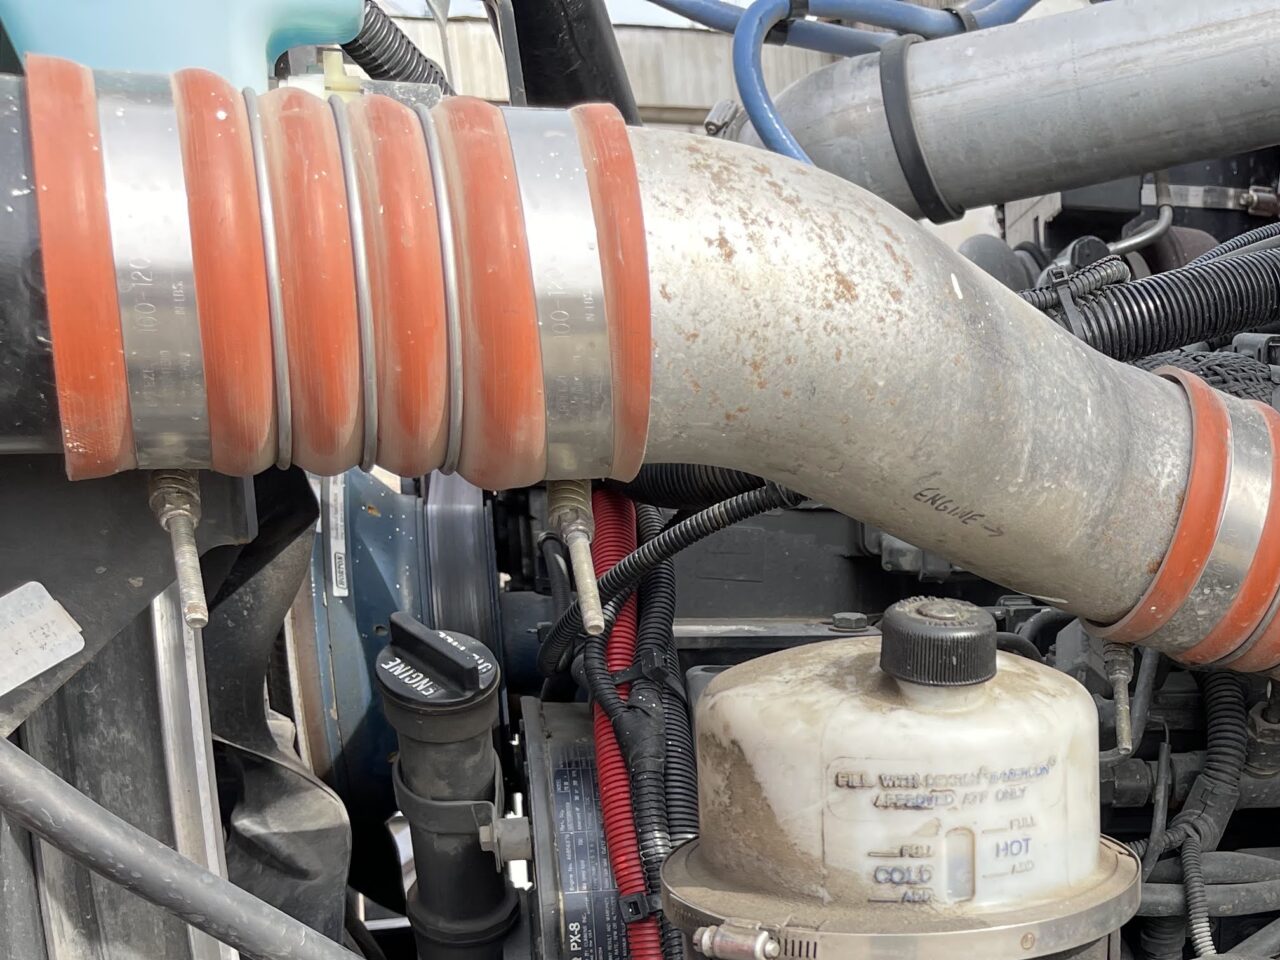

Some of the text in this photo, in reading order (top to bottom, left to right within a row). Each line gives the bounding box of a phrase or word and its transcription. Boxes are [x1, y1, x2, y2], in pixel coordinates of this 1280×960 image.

[913, 488, 985, 525] ENGINE
[381, 657, 436, 696] ENGINE
[995, 838, 1032, 858] HOT
[874, 864, 934, 886] COLD
[569, 922, 581, 951] PX-8
